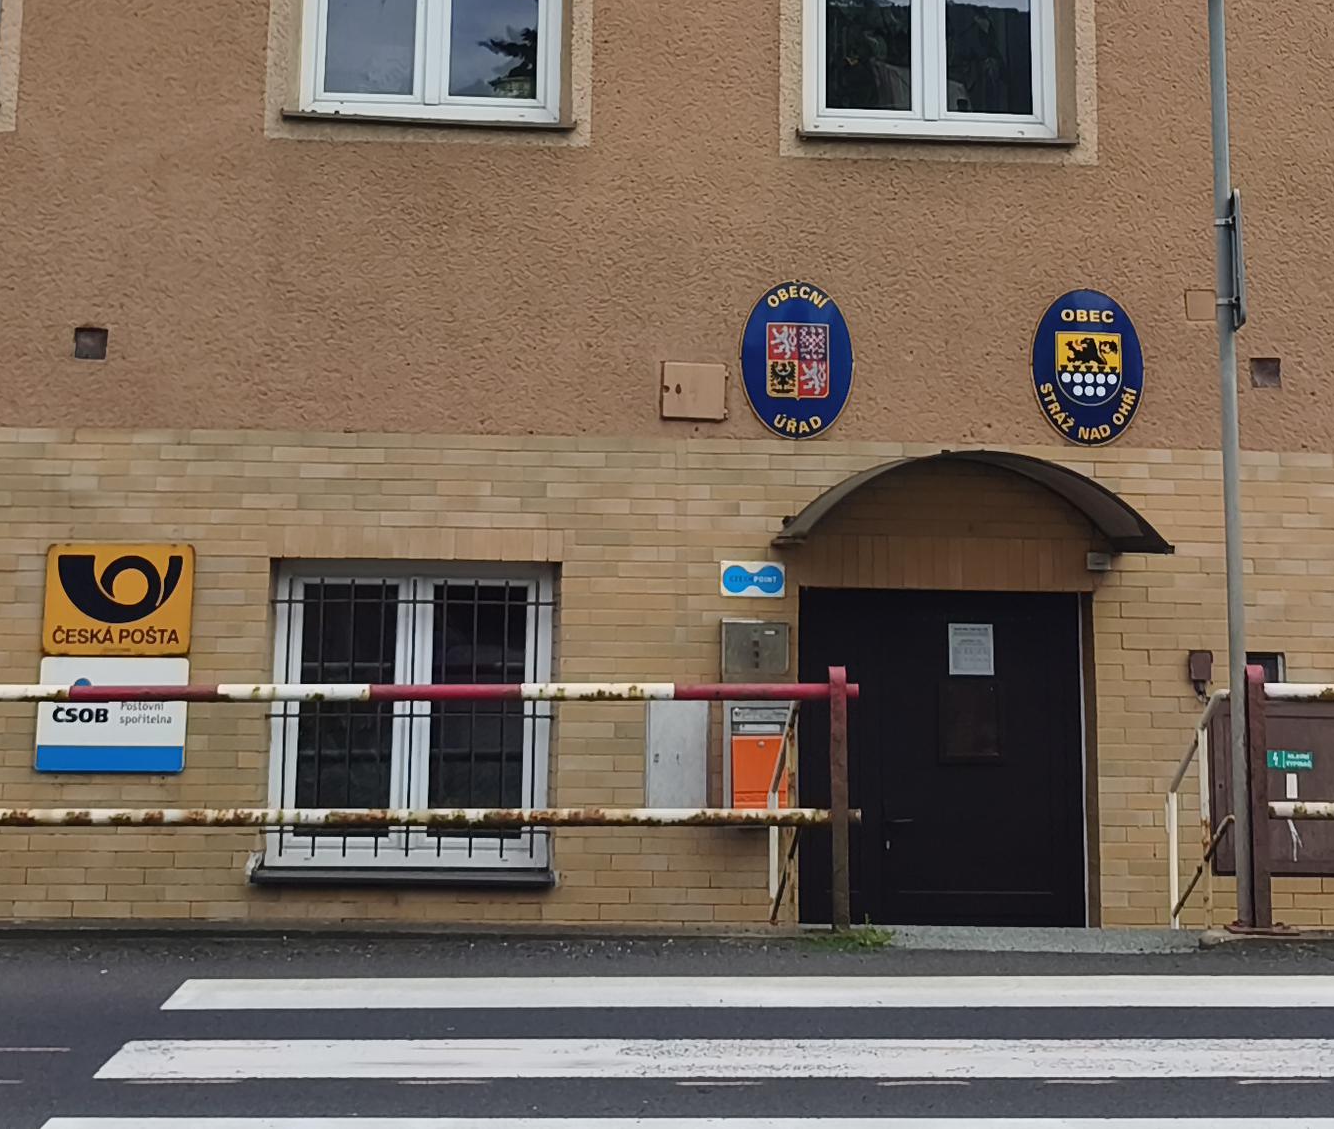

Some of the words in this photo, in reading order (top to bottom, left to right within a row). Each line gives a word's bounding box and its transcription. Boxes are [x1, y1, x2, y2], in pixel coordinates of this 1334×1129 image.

[767, 285, 830, 308] OBECNÍ
[1060, 308, 1114, 323] OBEC
[1040, 382, 1075, 432] STRÁŽ
[1077, 424, 1111, 440] NAD
[1112, 386, 1137, 425] OHŘÍ
[773, 413, 822, 433] ÚŘAD
[52, 625, 114, 644] ČESKÁ
[118, 625, 180, 644] POŠTA
[52, 705, 109, 723] ČSOB
[119, 713, 172, 726] spořitelna
